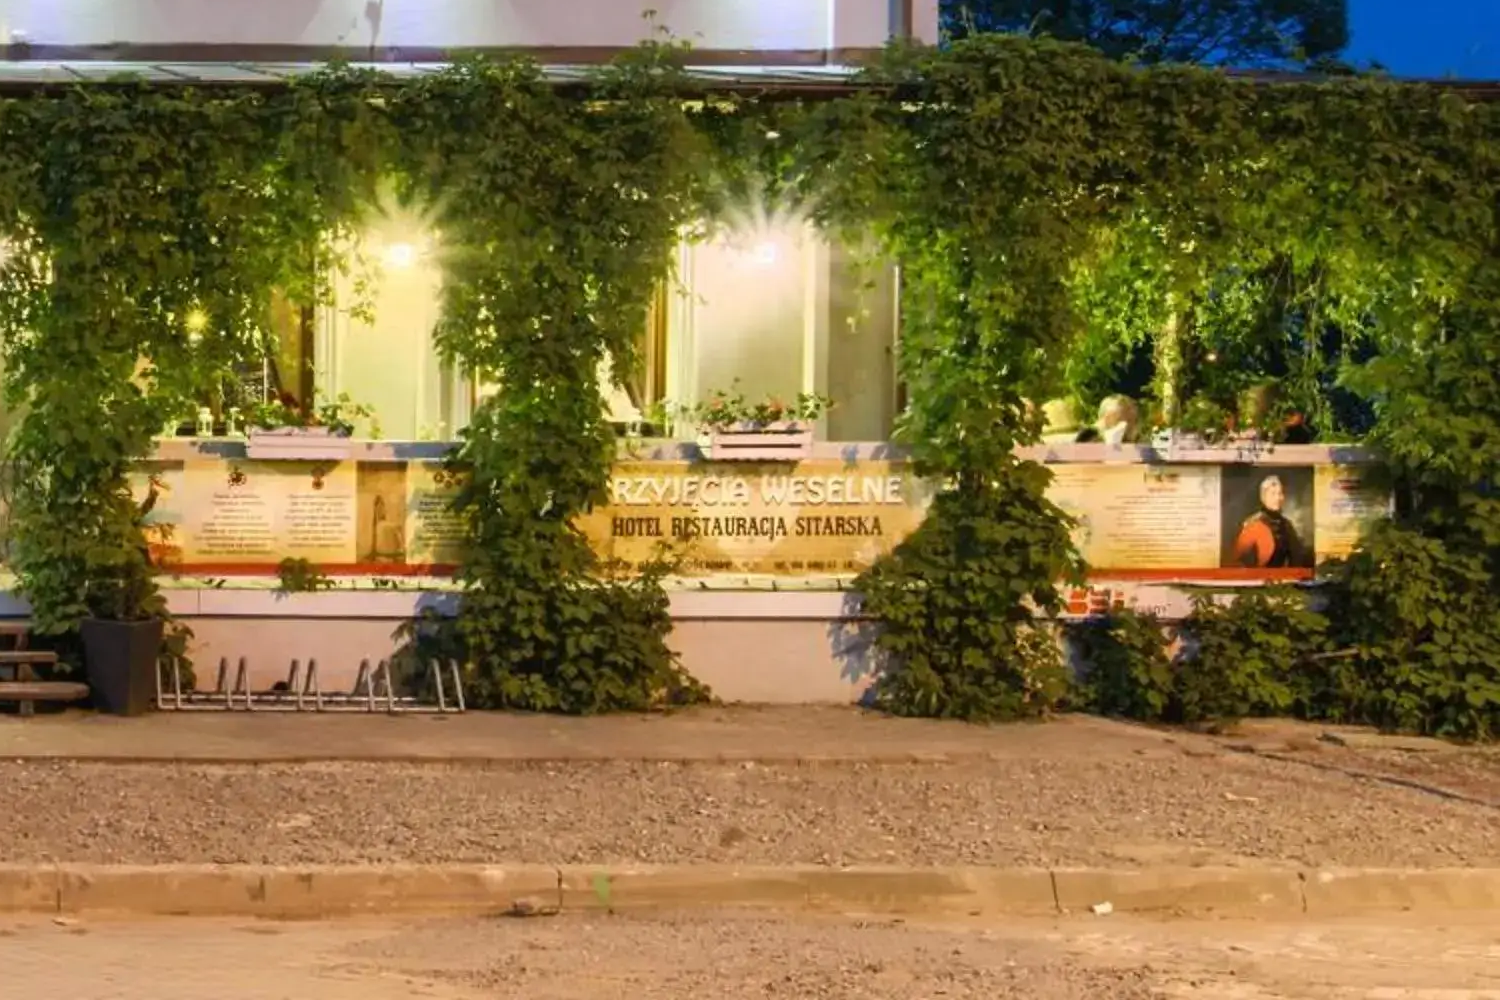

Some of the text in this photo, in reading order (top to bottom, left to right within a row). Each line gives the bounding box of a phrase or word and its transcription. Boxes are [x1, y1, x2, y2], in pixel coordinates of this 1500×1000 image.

[607, 475, 904, 512] RZYJĘCIA WESELNE
[611, 515, 882, 541] HOTEL RESTAURACJA SITARSKA
